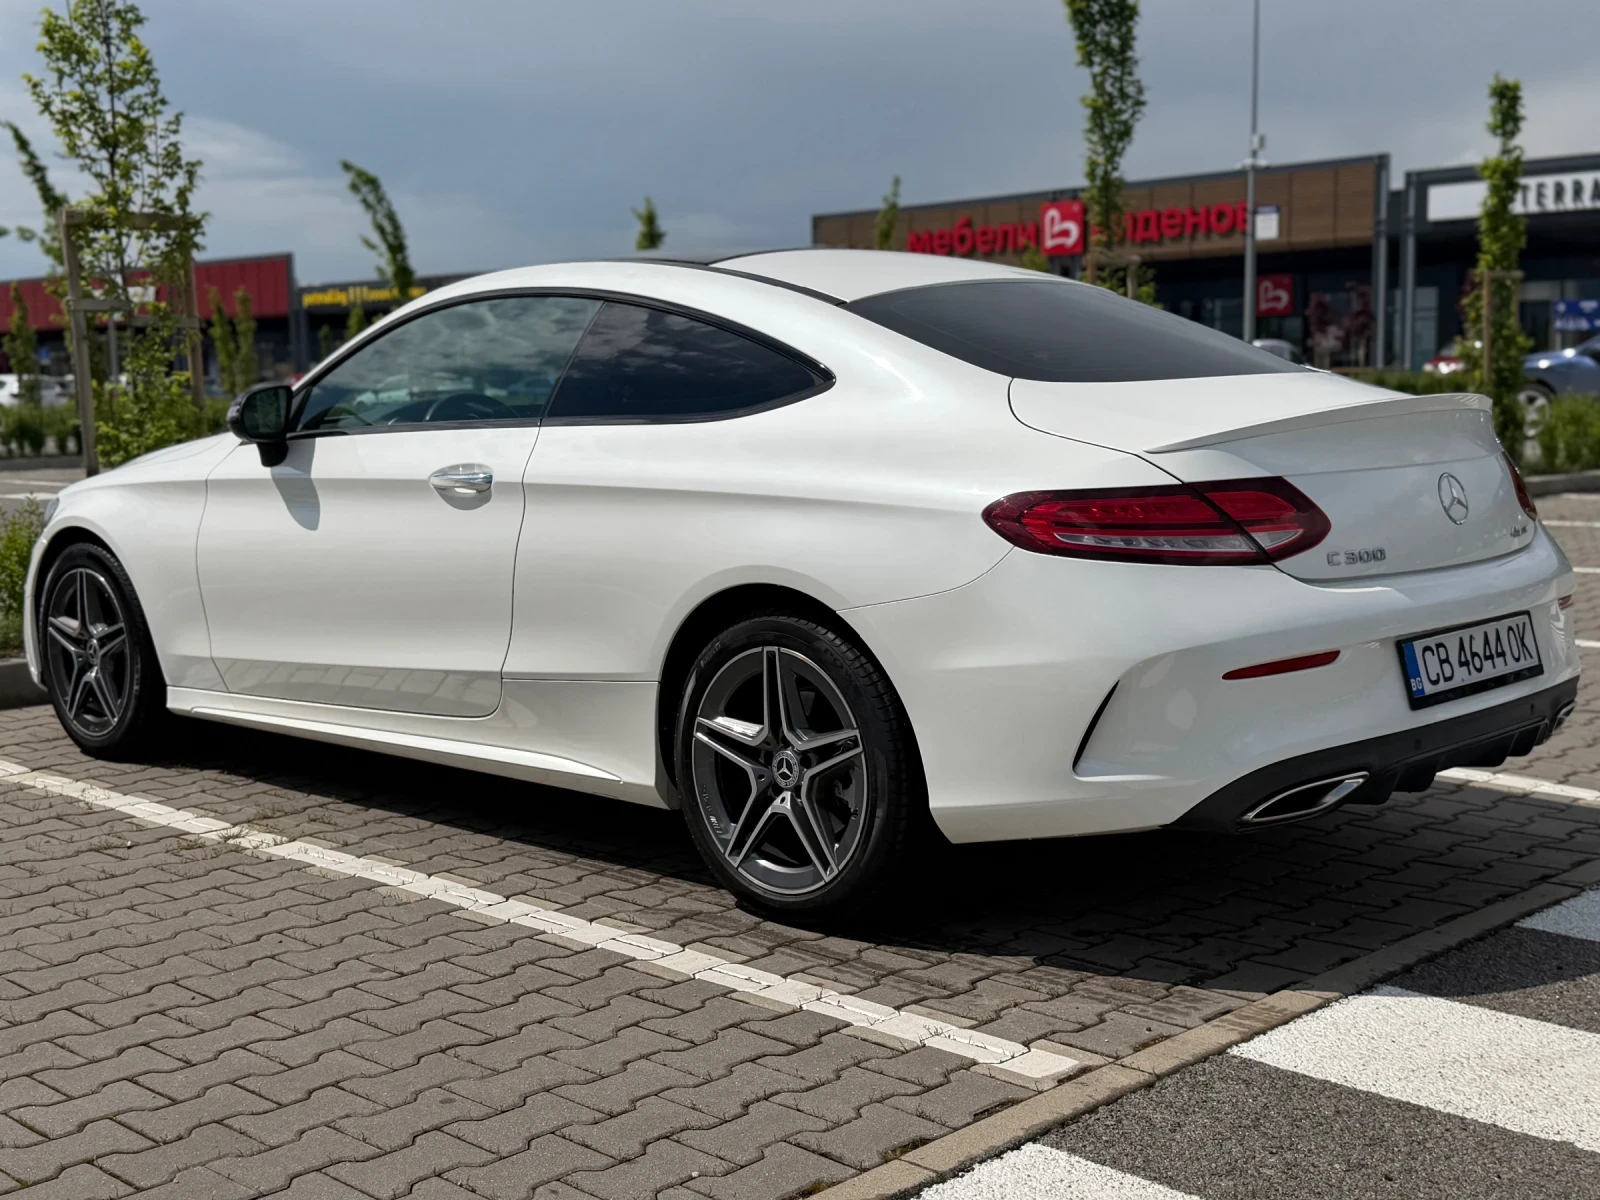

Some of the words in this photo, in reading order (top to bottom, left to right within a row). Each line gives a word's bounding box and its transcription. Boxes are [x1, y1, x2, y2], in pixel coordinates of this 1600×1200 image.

[907, 215, 1039, 255] мебели
[1326, 551, 1341, 566] C
[1344, 548, 1386, 565] 300
[1421, 642, 1454, 686] CB
[1458, 628, 1508, 676] 4644
[1410, 678, 1423, 691] BG
